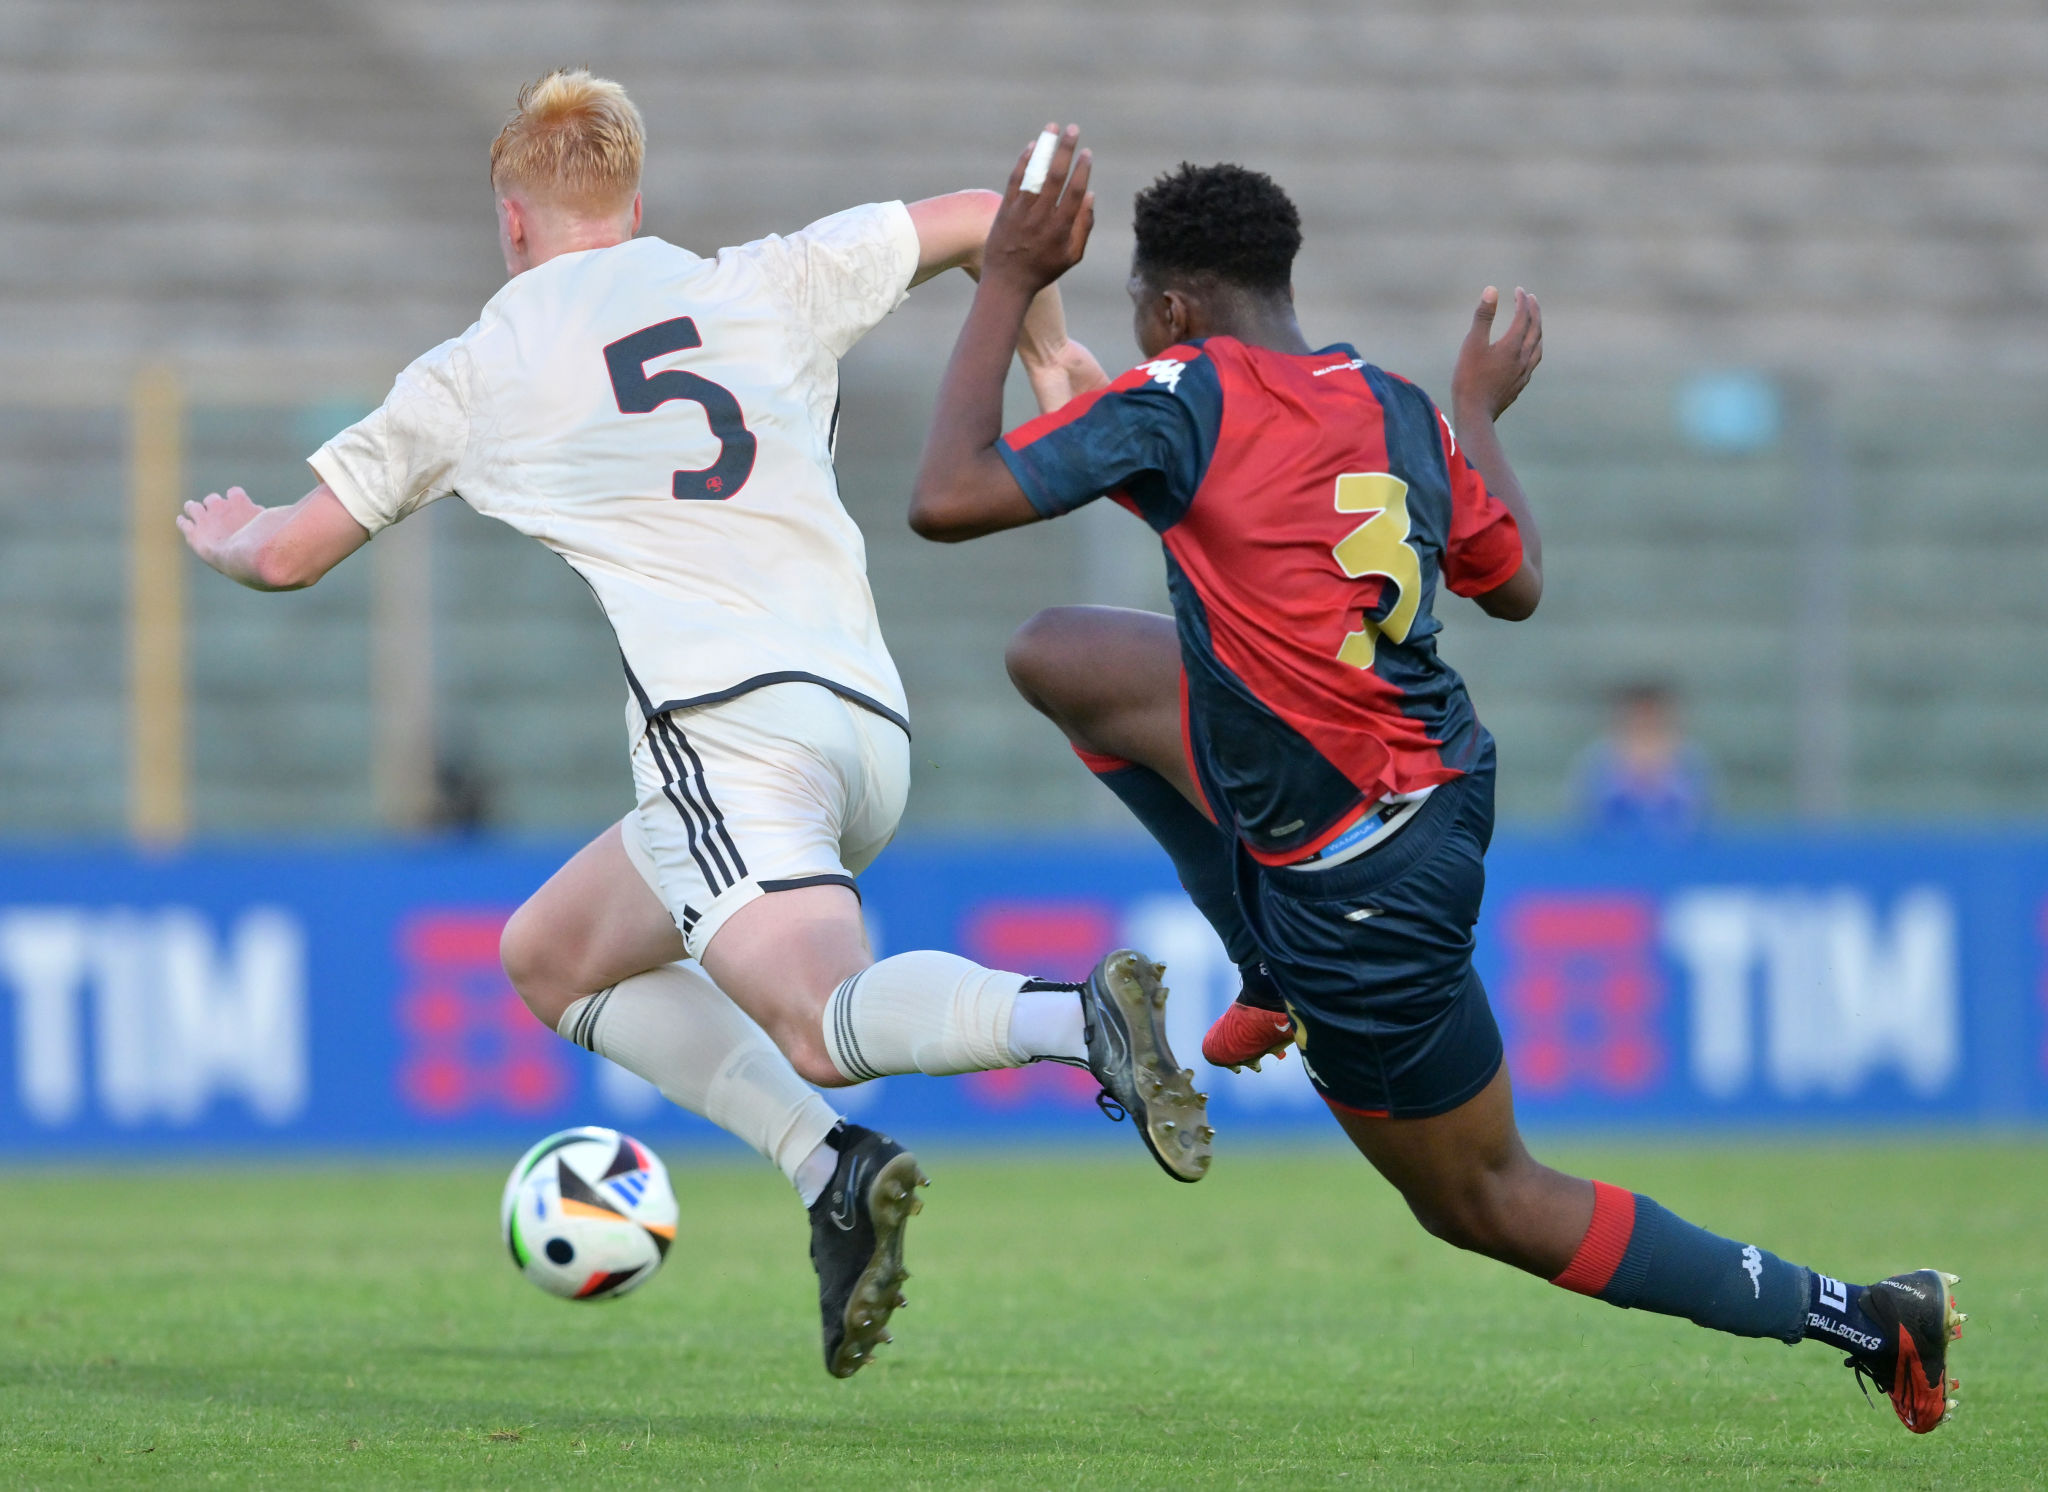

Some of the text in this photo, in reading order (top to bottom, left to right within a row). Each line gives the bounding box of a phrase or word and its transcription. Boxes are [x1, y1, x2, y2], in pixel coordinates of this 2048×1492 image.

[602, 315, 757, 500] 5
[1332, 471, 1422, 670] 3
[1, 905, 306, 1128] TIM
[1667, 885, 1957, 1097] TIM
